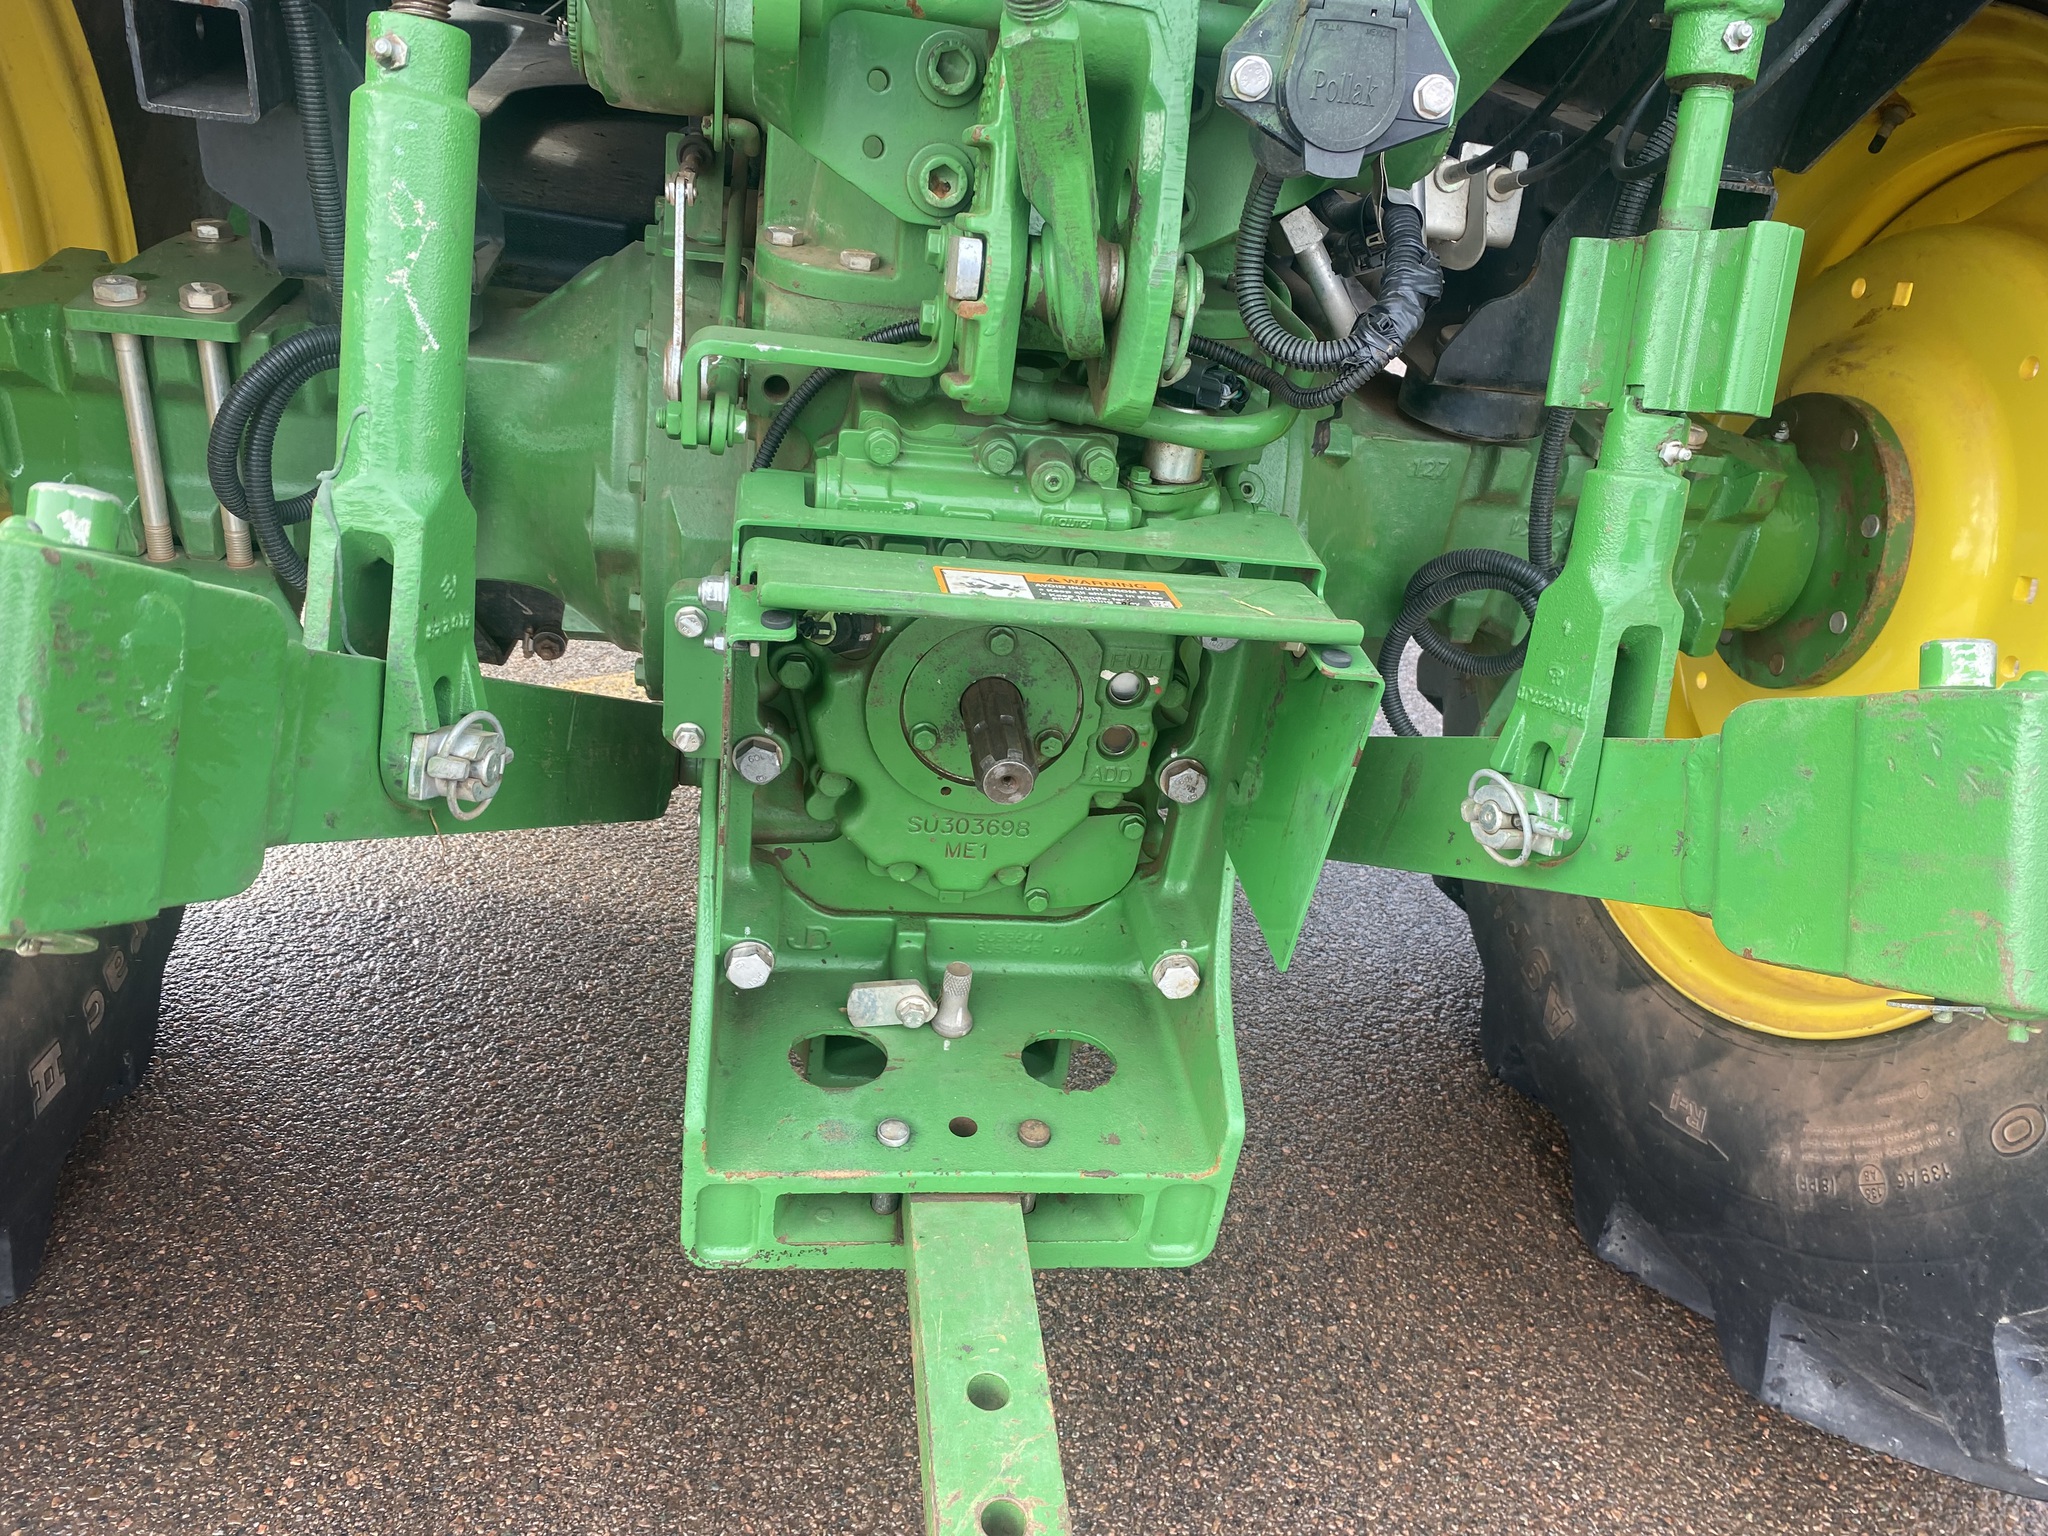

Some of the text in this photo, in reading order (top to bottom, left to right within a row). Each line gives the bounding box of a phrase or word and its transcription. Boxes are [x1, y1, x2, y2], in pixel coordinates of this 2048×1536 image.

[1309, 69, 1378, 107] Pollak
[1063, 578, 1147, 589] WARNING
[1090, 765, 1133, 783] ADD
[907, 816, 1031, 838] SU303698
[944, 841, 988, 860] ME1
